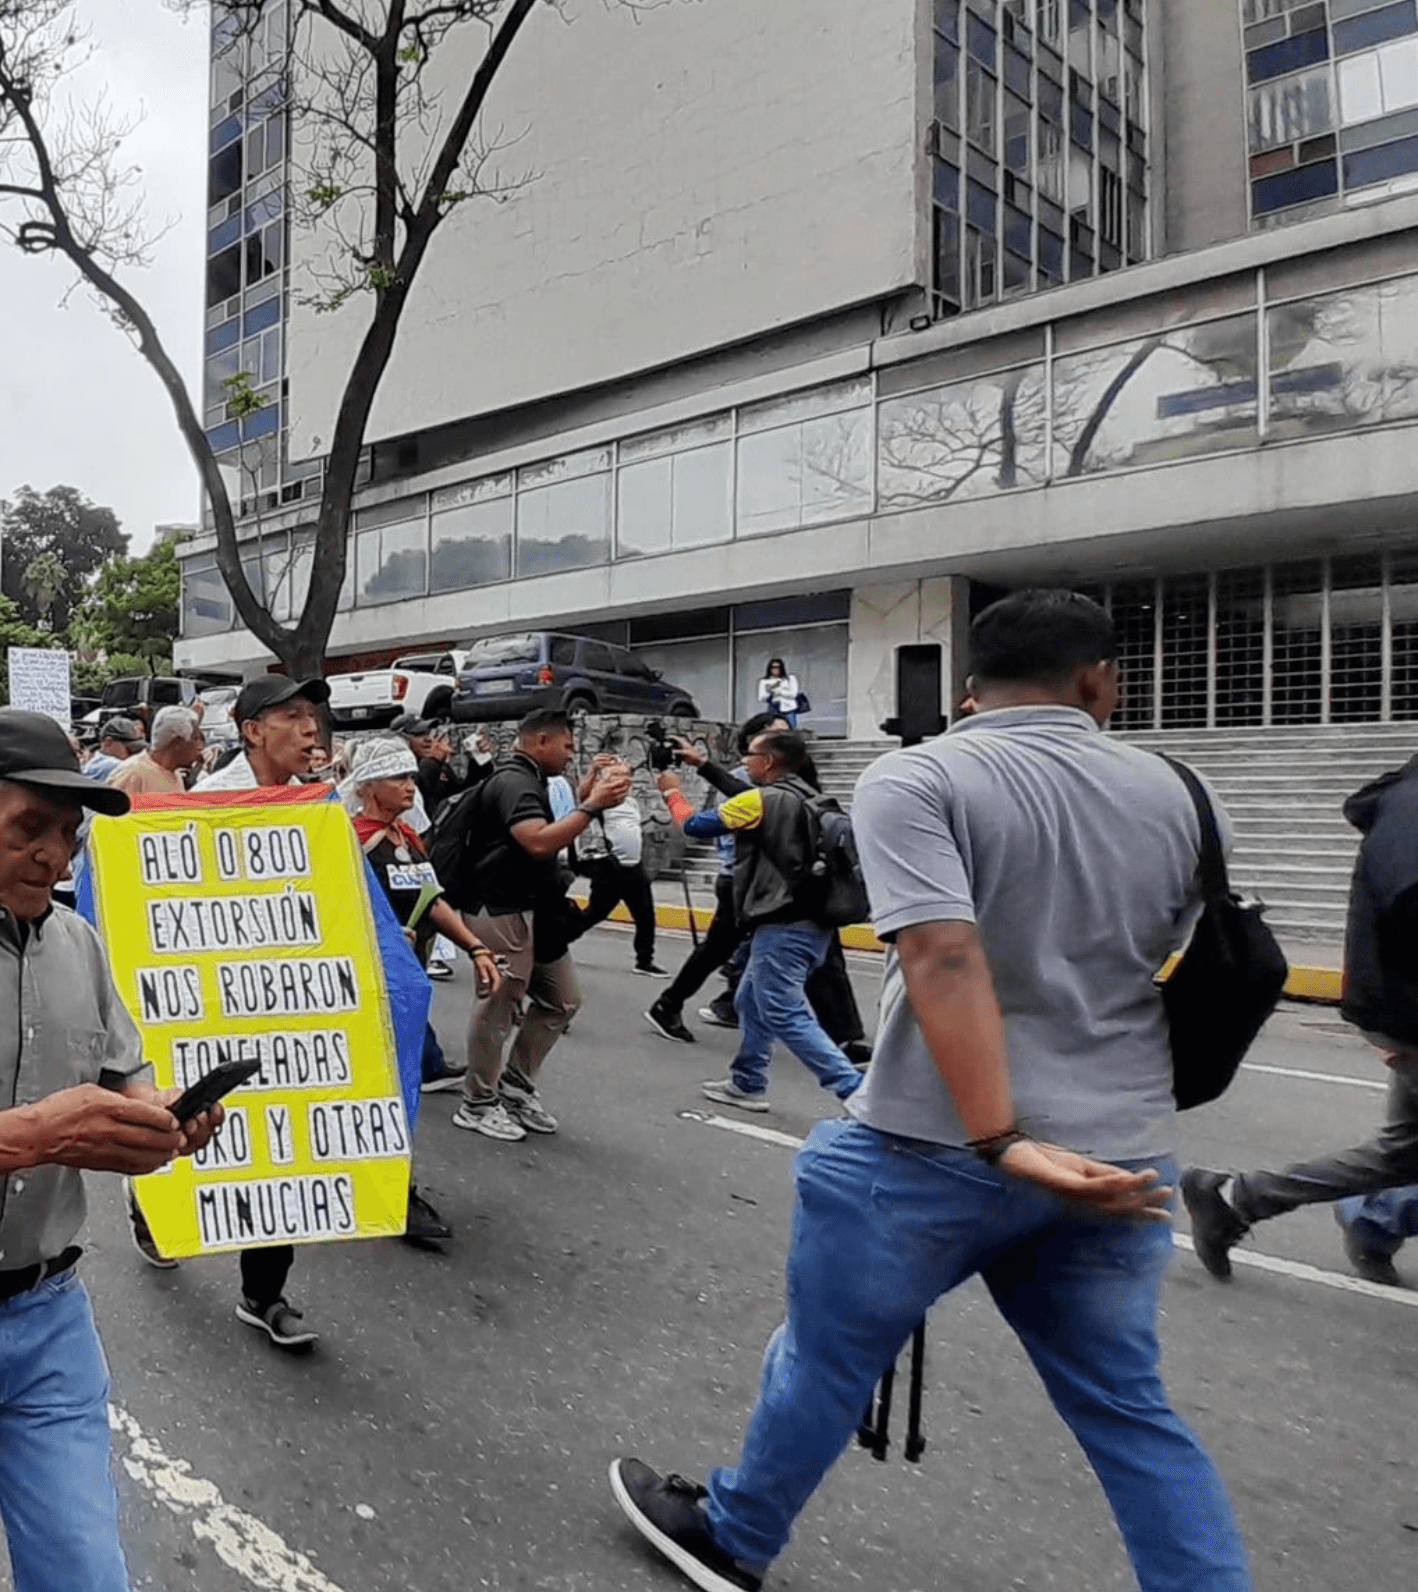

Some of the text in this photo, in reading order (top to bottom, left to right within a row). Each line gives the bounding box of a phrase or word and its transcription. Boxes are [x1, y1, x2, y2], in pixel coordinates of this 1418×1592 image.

[142, 822, 197, 881] ALÓ
[150, 885, 318, 949] EXTORSIÓN
[140, 959, 357, 1020] NOS ROBARON
[268, 1107, 286, 1160] Y
[312, 1101, 405, 1157] OTRAS
[198, 1177, 352, 1243] MINUCIAS
